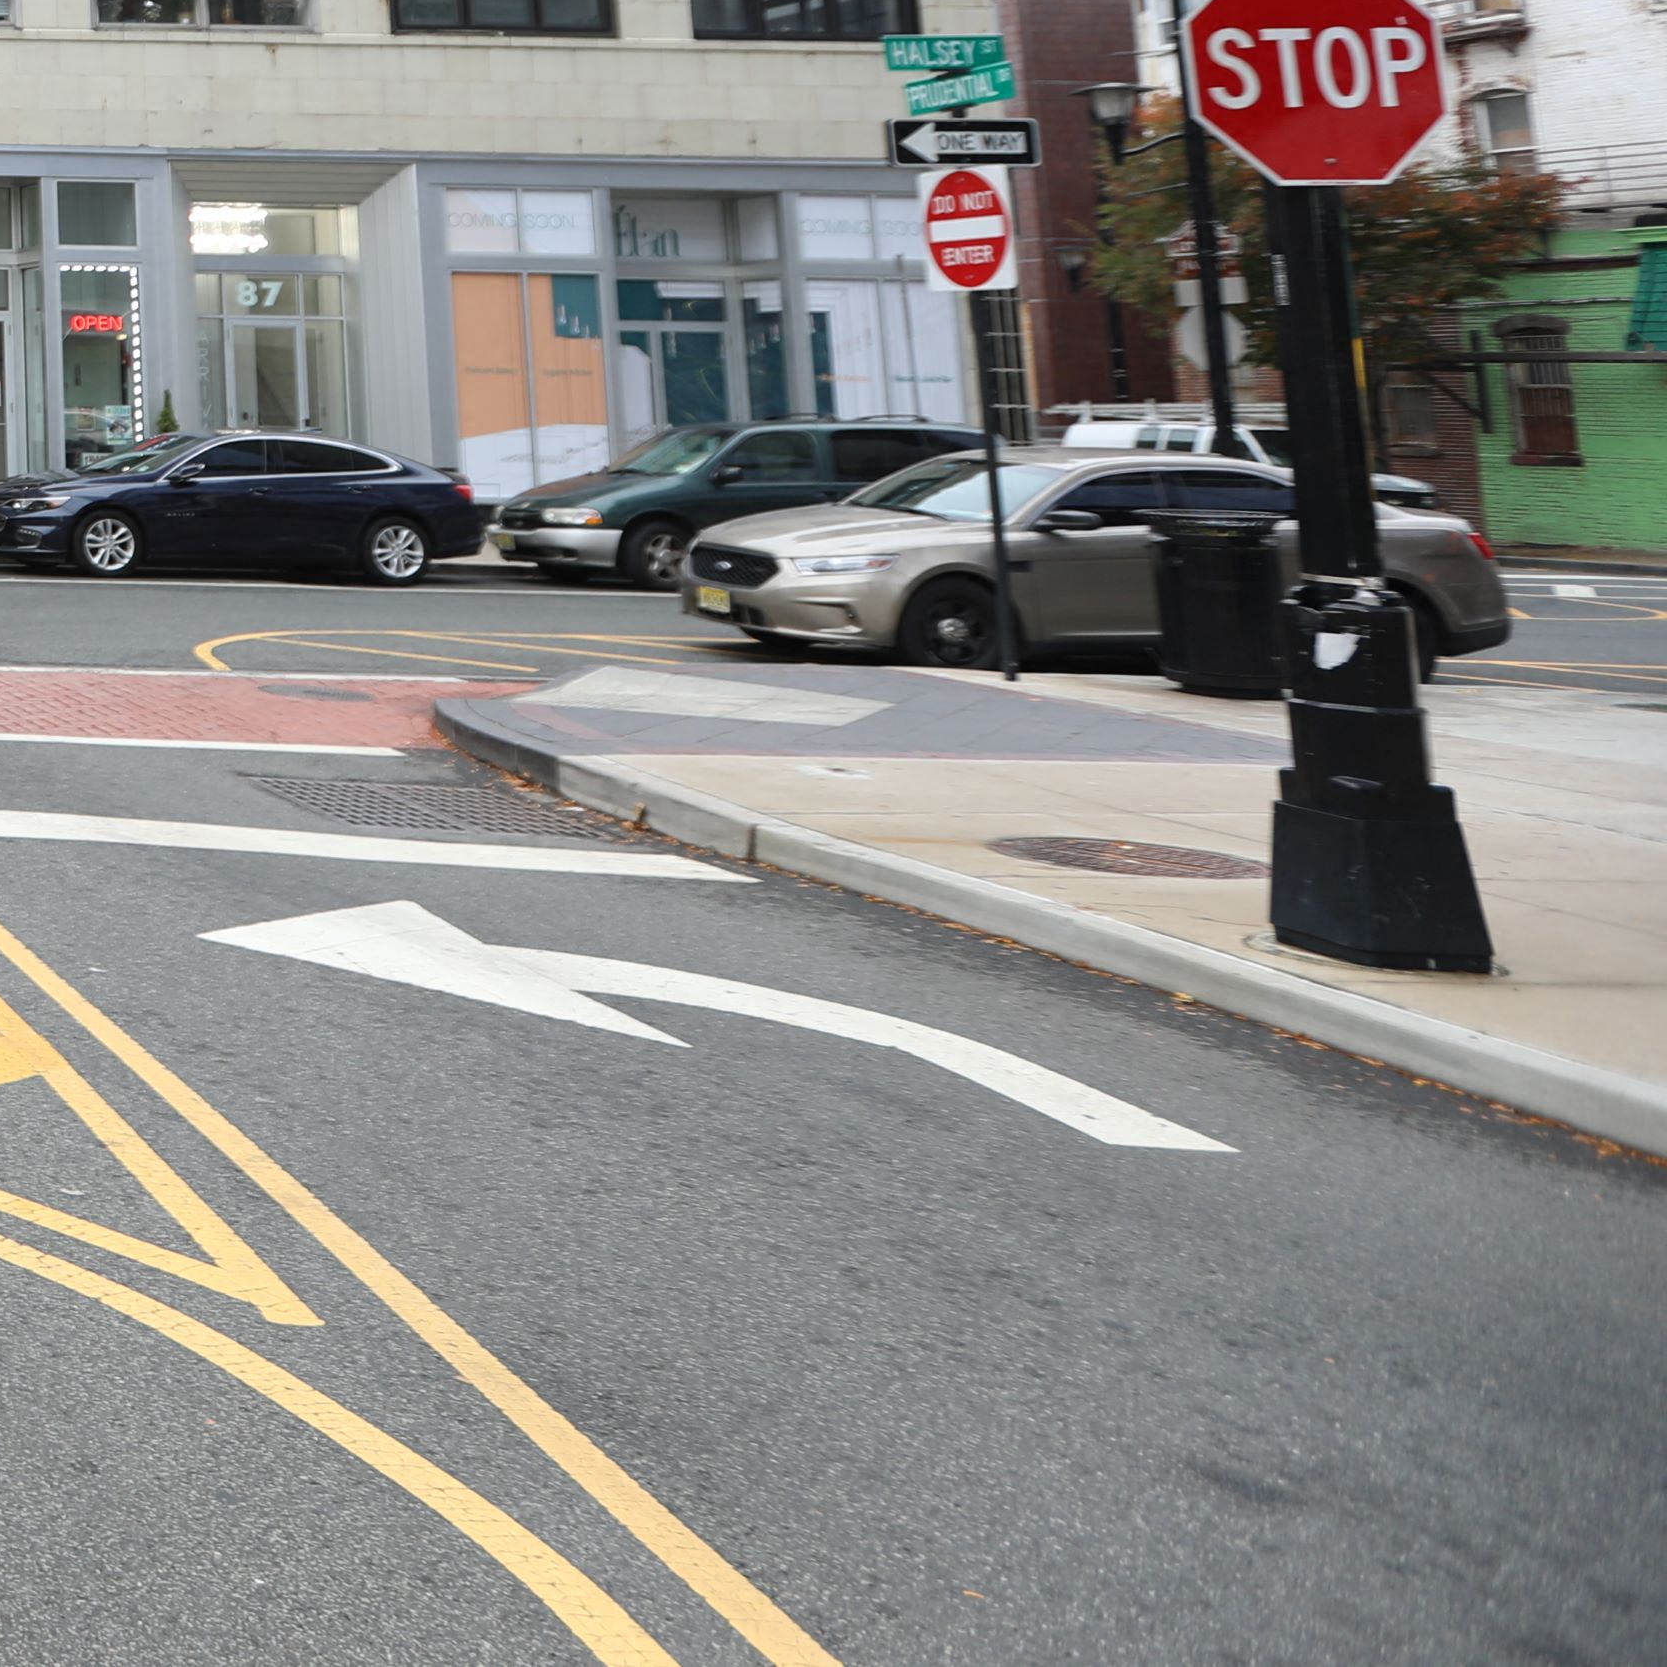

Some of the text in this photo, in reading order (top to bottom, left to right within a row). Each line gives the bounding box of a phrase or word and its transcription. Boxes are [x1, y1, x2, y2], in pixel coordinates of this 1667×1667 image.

[892, 40, 976, 66] HALSEY
[1205, 26, 1427, 109] STOP
[907, 72, 1000, 109] PRUDENTIAL
[938, 133, 1023, 151] ONE WAY
[931, 191, 995, 215] DO NOT
[447, 212, 575, 230] COMING SOON
[940, 245, 996, 267] ENTER
[236, 280, 284, 307] 87
[72, 315, 124, 332] OPEN
